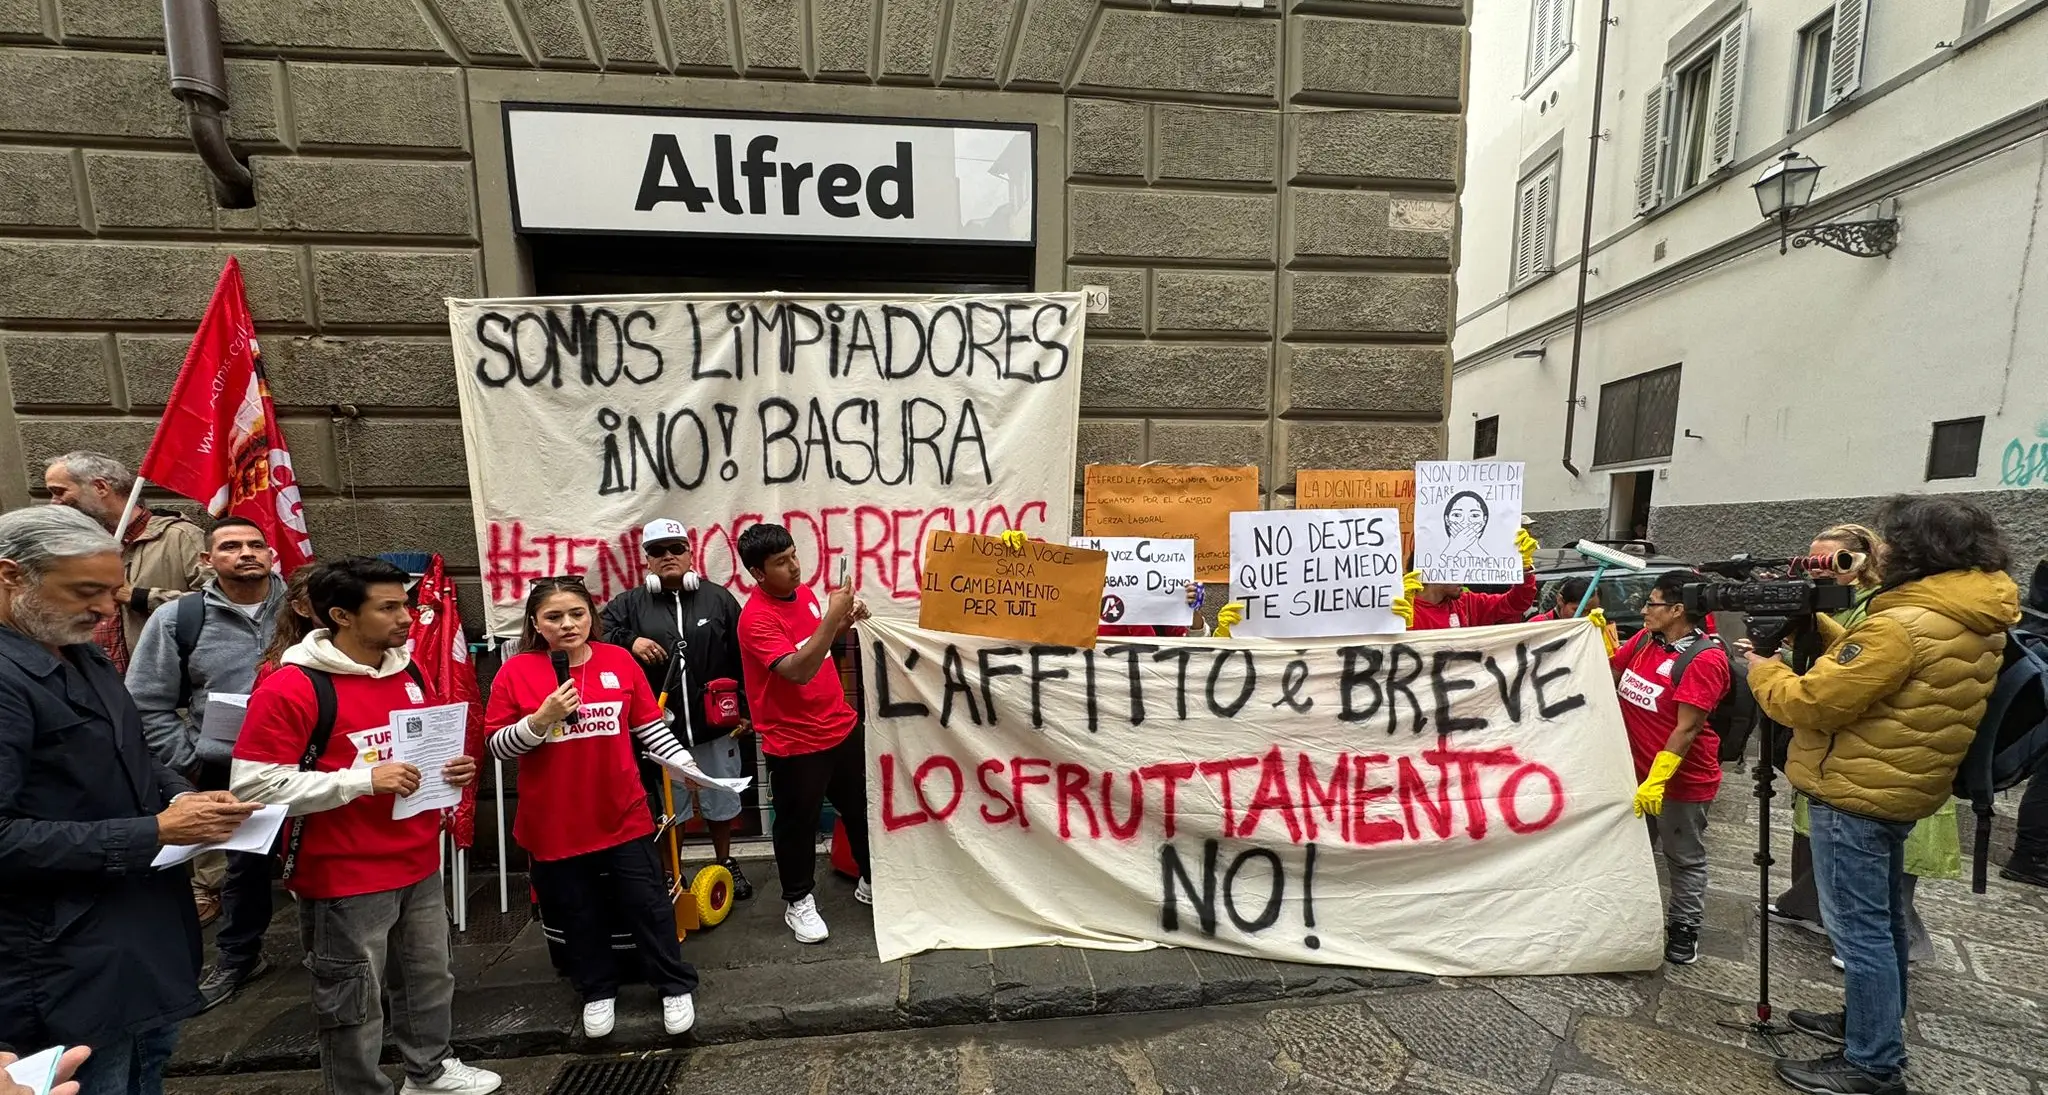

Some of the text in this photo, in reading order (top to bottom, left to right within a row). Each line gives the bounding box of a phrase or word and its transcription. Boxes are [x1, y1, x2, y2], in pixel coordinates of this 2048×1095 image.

[635, 133, 914, 219] Alfred
[477, 305, 664, 388] SOMOS
[757, 398, 992, 487] BASURA
[1125, 476, 1136, 484] LA
[1420, 464, 1519, 482] NON DITECI DI
[1143, 496, 1159, 504] POR
[1163, 496, 1173, 504] EL
[1178, 496, 1212, 504] CAMBIO
[1304, 481, 1319, 498] LA
[1375, 482, 1391, 497] NEL
[1420, 484, 1520, 505] STARE ZITTI
[1086, 508, 1164, 525] FUERZA LABORAL
[666, 522, 681, 534] 23
[1253, 525, 1293, 557] NO
[1308, 517, 1384, 553] DEJES
[933, 533, 1074, 565] LA NOSTRA VOCE
[1111, 551, 1134, 562] VOZ
[996, 559, 1035, 577] SARA
[1416, 553, 1432, 568] LO
[1240, 553, 1398, 590] QUE EL MIEDO
[1421, 568, 1447, 582] NON
[1464, 568, 1523, 582] ACCETTABILE
[925, 572, 1060, 601] IL CAMBIAMENTO
[964, 598, 1037, 618] PER TUTTI
[1236, 585, 1393, 620] TE SILENCIE
[873, 640, 1254, 733] L'AFFITTO
[1336, 640, 1586, 737] BREVE
[878, 738, 1566, 844] LO SFRUTTAMENTO
[1158, 841, 1323, 950] NO!
